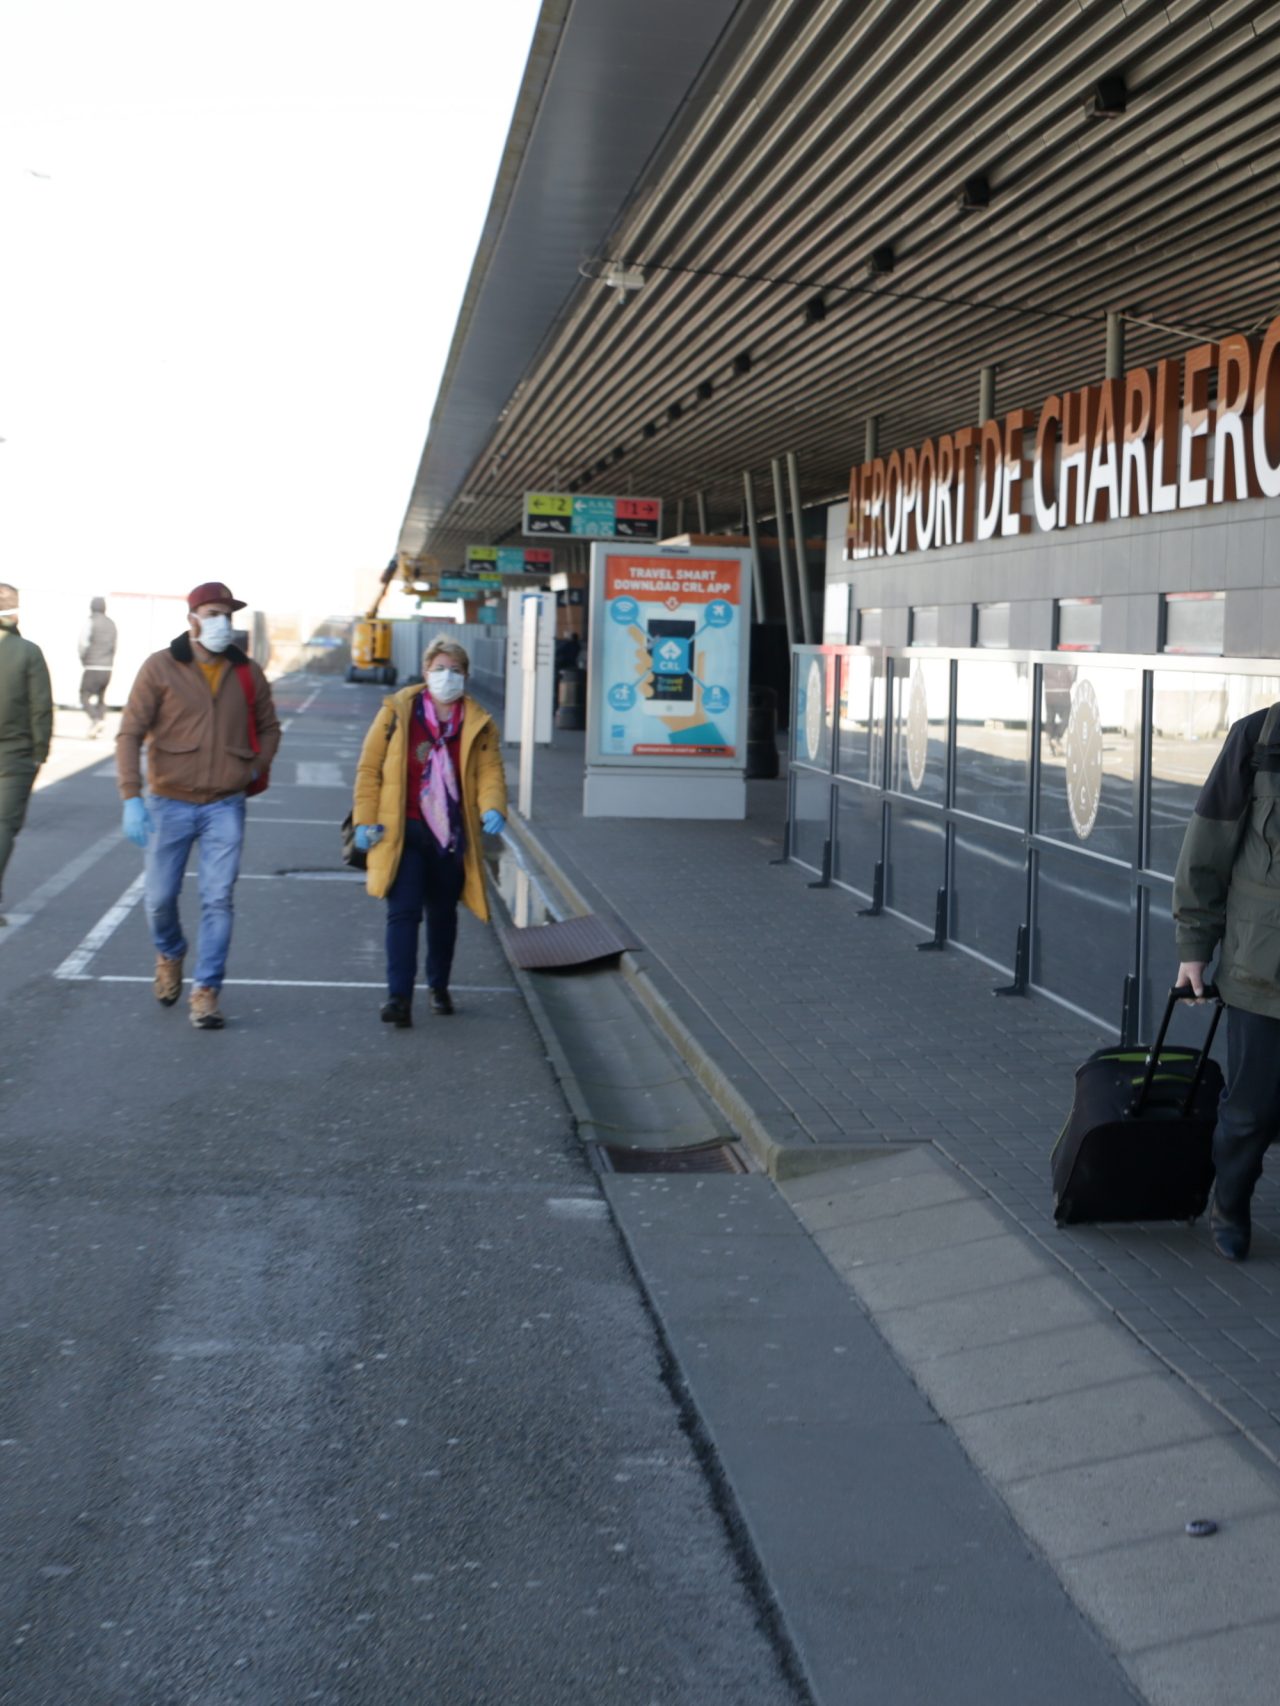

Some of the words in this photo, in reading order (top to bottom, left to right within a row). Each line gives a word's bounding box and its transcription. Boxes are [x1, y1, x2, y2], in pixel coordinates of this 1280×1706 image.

[842, 427, 976, 561] AEROPORT
[977, 409, 1030, 541] DE
[629, 566, 674, 580] TRAVEL
[675, 568, 717, 581] SMART
[613, 579, 680, 592] DOWNLOAD
[681, 581, 705, 593] CRL
[706, 582, 731, 594] APP
[659, 660, 681, 671] CRL
